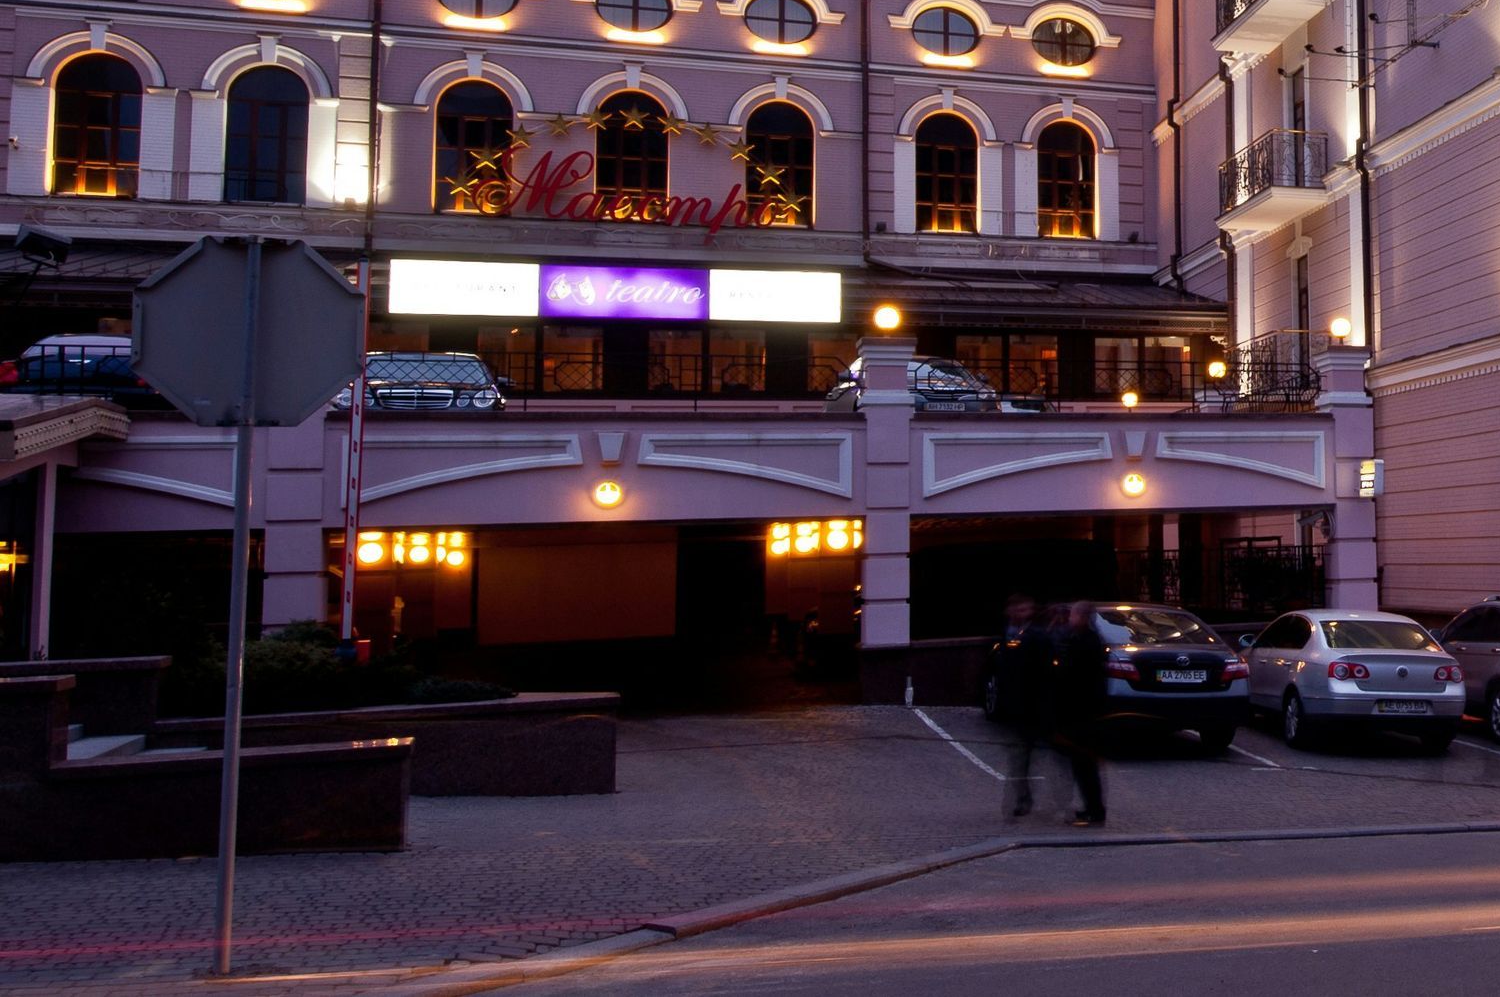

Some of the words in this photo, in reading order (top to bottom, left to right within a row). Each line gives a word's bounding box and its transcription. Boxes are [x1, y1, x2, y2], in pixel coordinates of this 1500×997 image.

[605, 279, 705, 305] teatro
[1162, 670, 1173, 680] AA
[1193, 670, 1205, 680] EE
